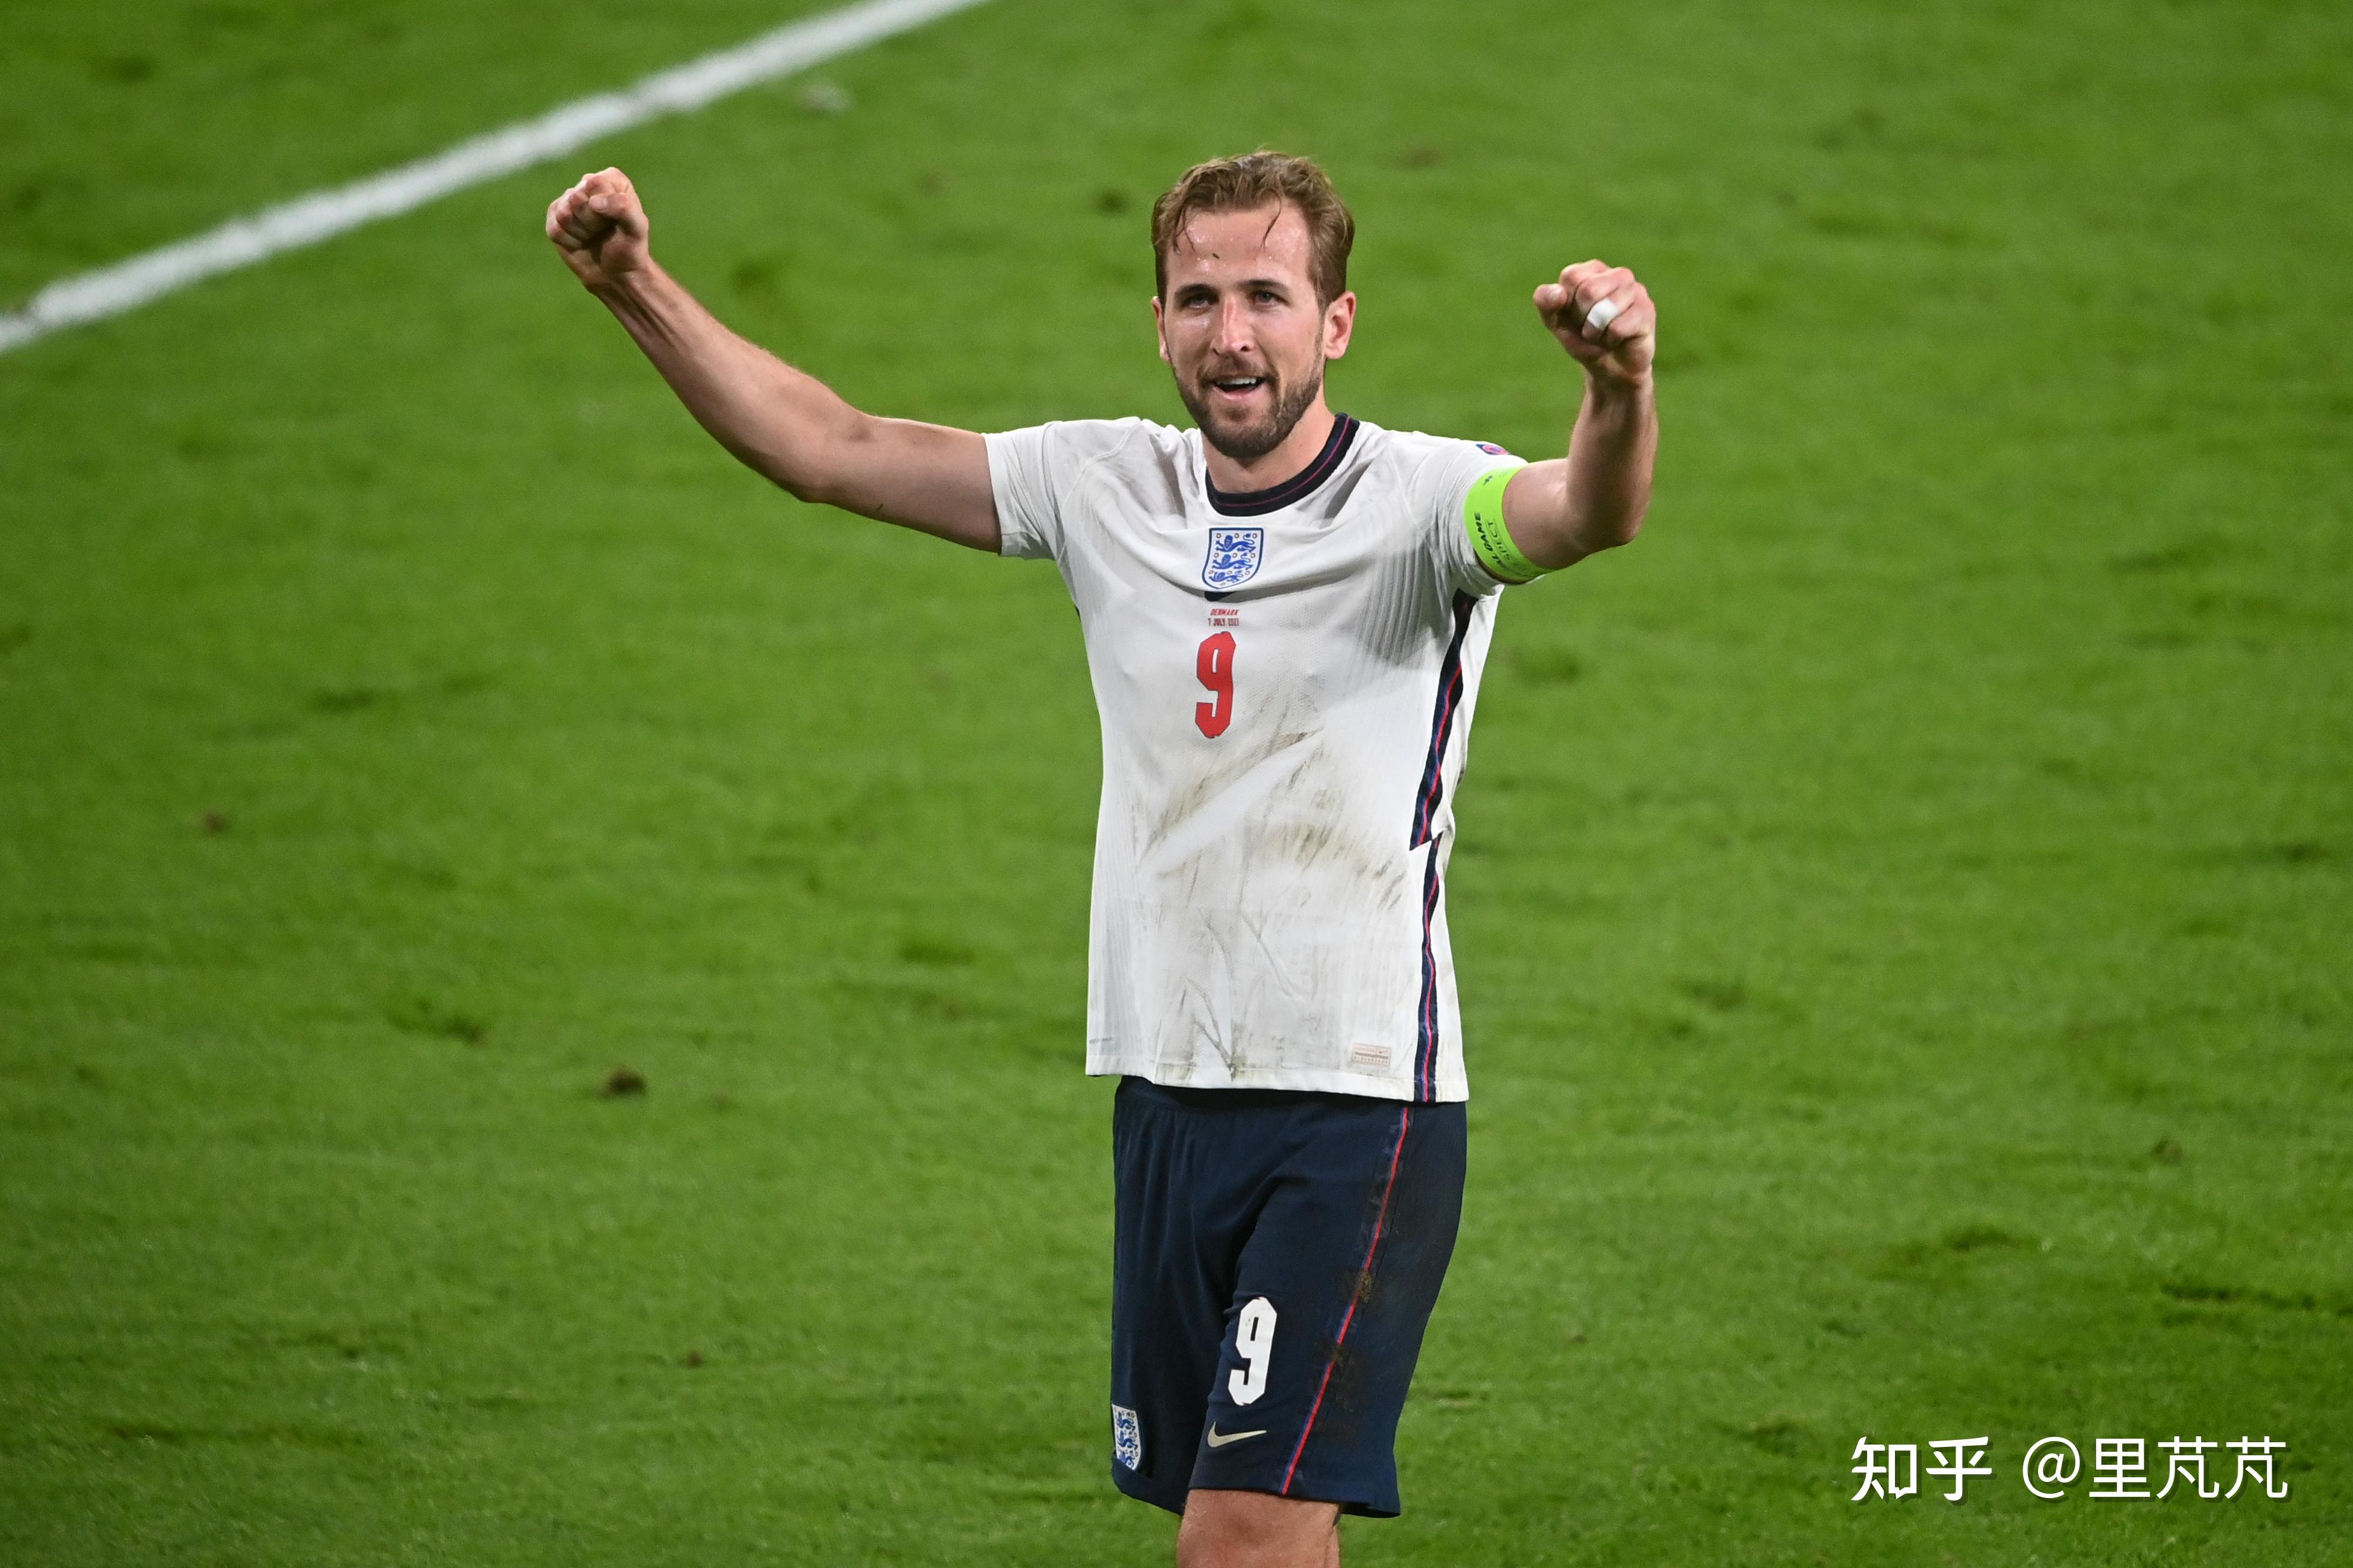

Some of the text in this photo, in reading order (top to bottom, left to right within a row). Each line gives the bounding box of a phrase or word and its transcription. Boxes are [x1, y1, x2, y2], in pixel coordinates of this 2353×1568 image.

[1474, 513, 1493, 552] GAME
[1213, 618, 1226, 626] JULY
[1195, 631, 1236, 738] 9
[1228, 1297, 1277, 1406] 9
